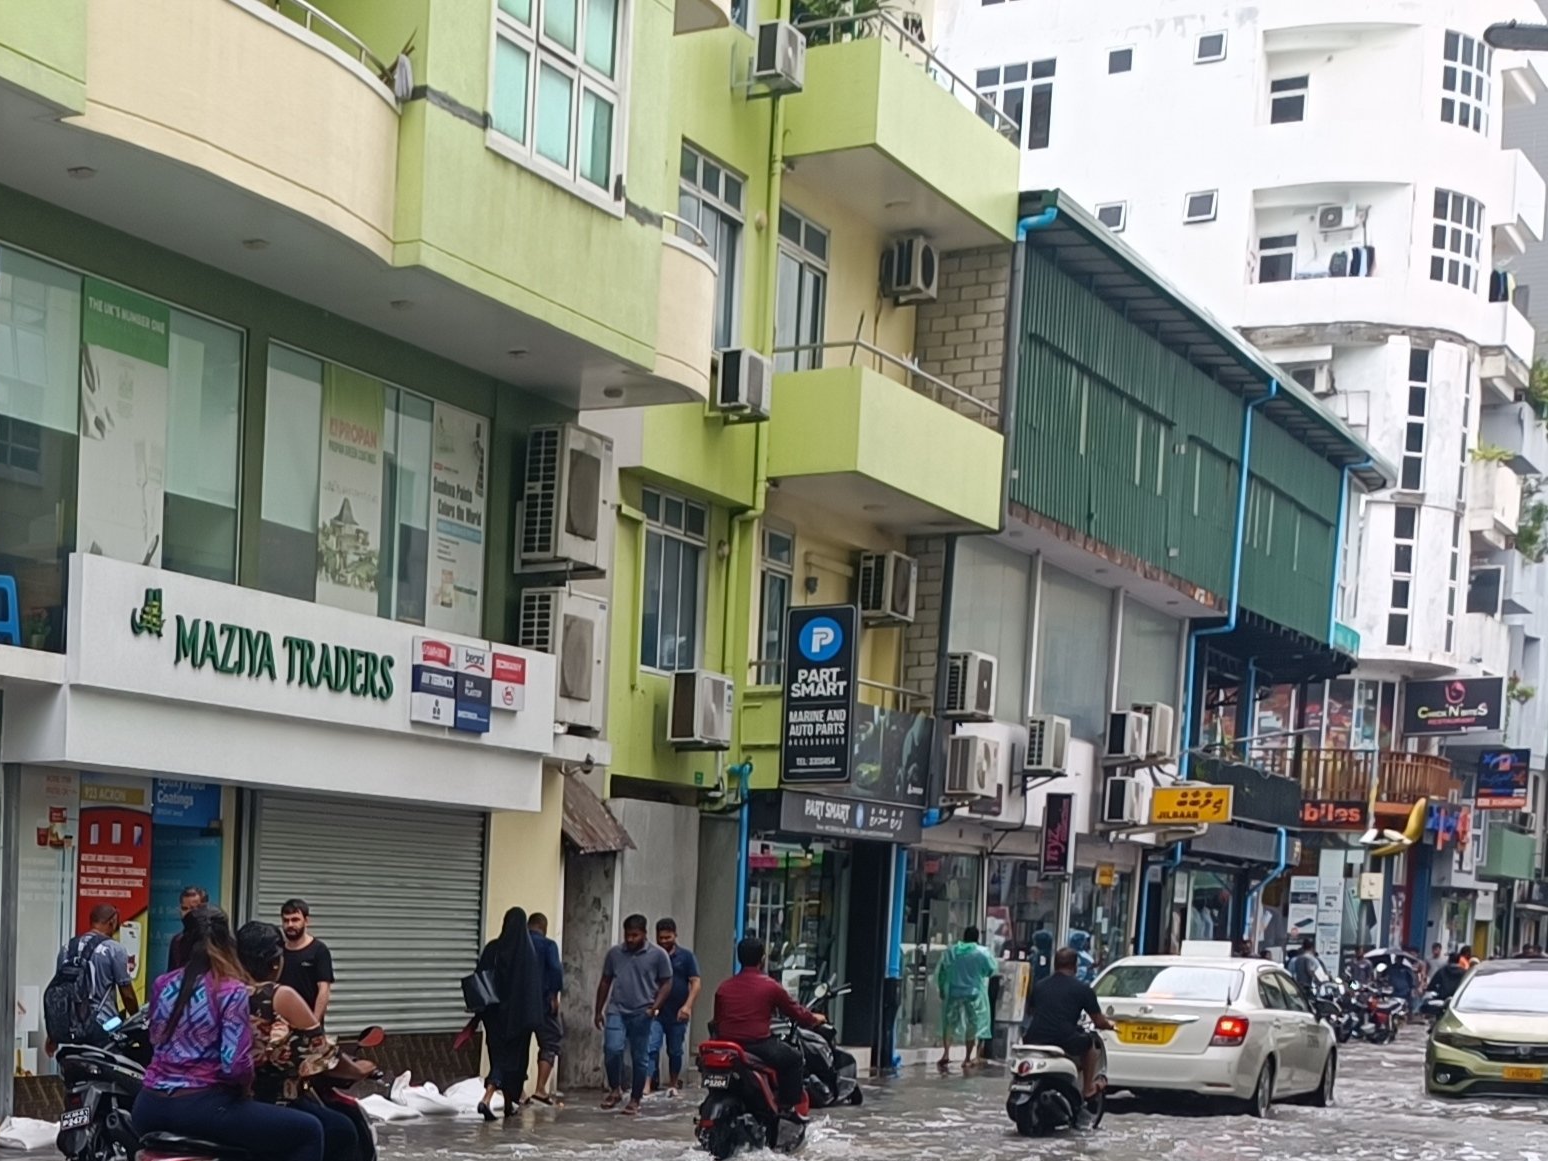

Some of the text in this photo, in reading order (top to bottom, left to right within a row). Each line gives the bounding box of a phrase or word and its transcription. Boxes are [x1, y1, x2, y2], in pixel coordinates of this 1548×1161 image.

[174, 615, 395, 701] MAZIYA TRADERS
[797, 667, 840, 684] PART
[790, 681, 847, 698] SMART
[788, 708, 847, 724] MARINE AND
[789, 722, 845, 738] AUTO PARTS
[157, 789, 194, 810] Coatings
[1299, 802, 1362, 822] biles
